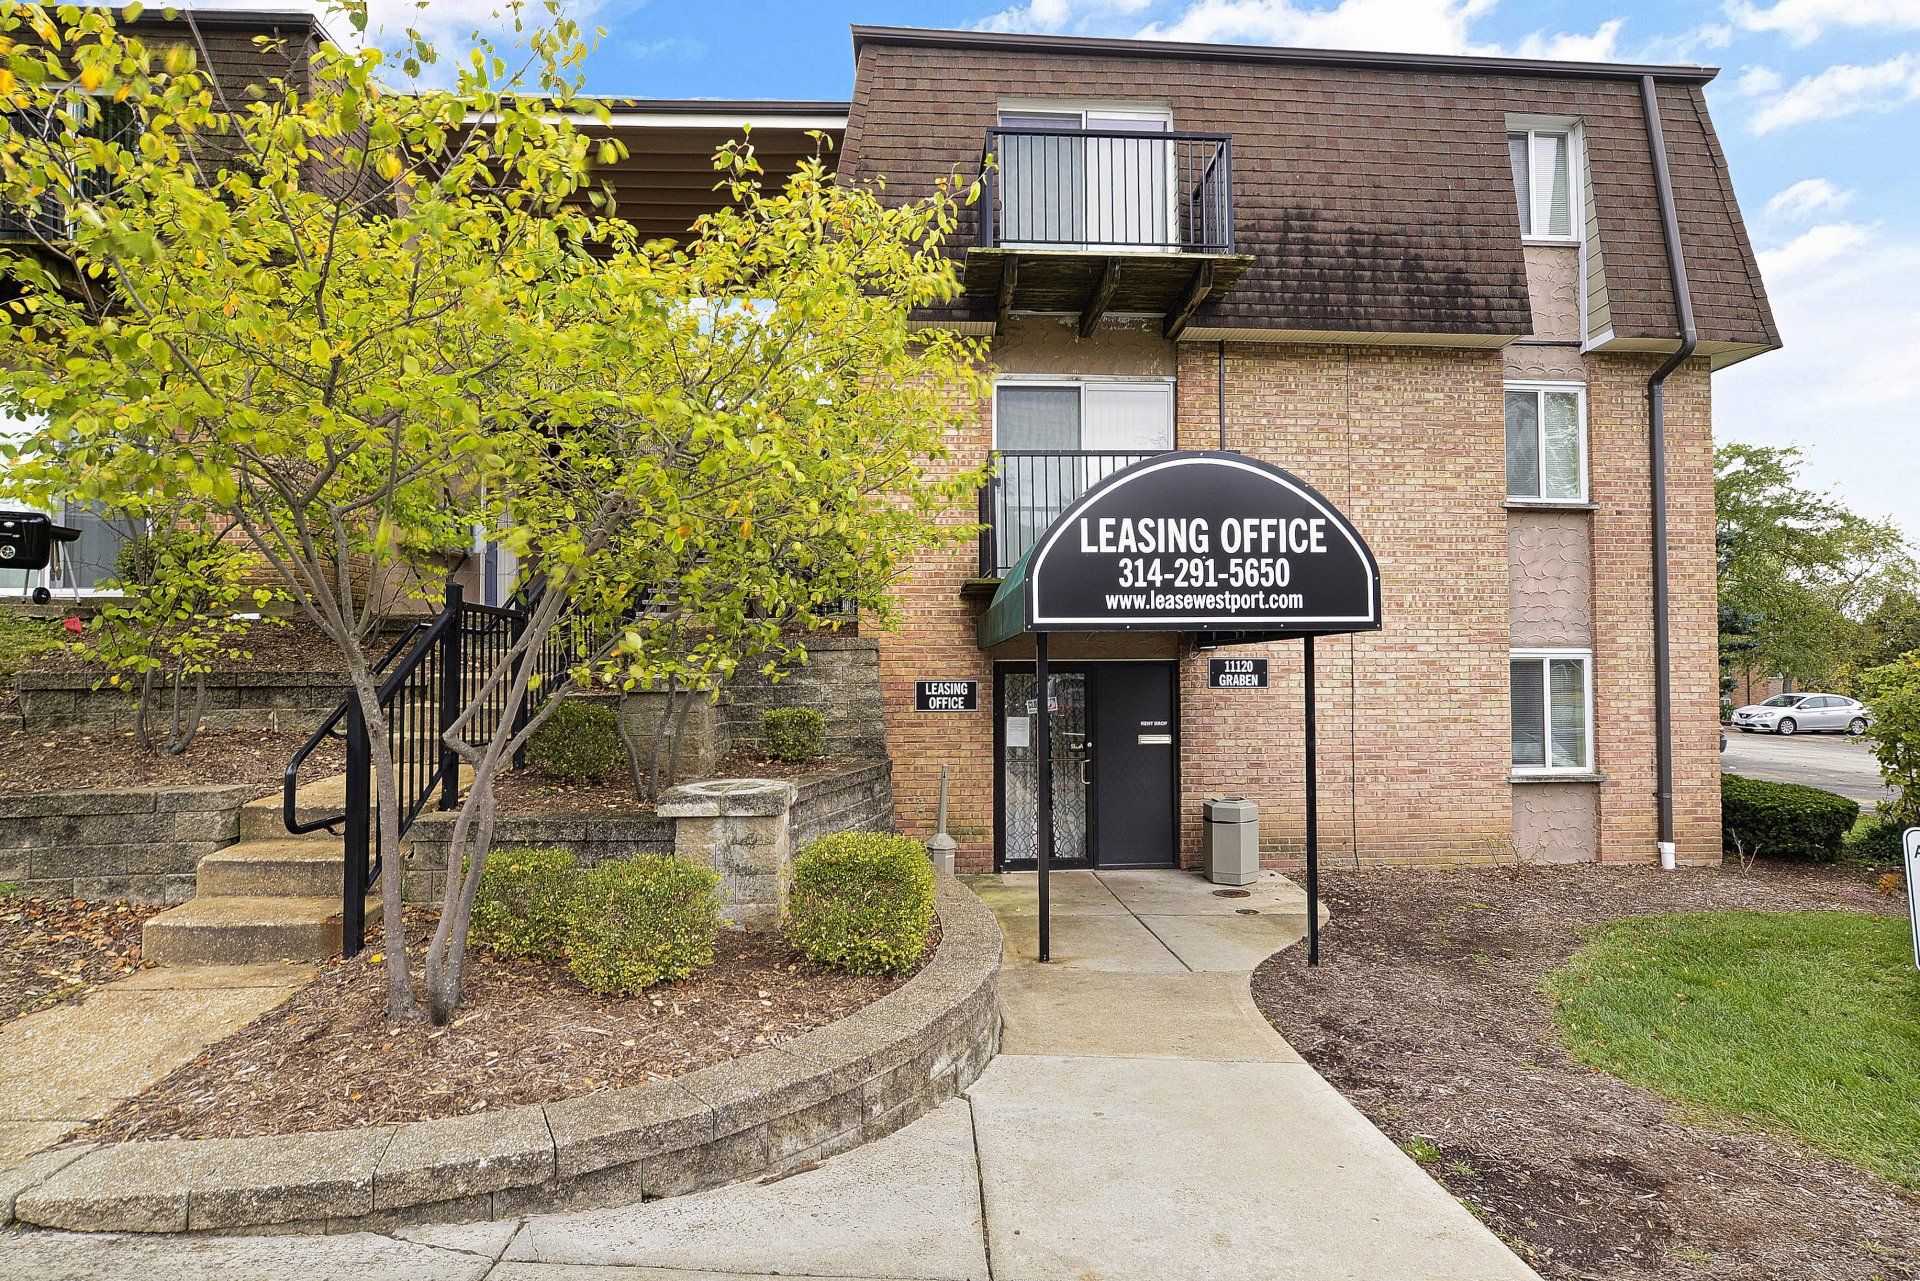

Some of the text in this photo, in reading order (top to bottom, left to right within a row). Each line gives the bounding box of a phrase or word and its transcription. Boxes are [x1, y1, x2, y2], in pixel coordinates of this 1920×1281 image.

[1080, 517, 1327, 553] LEASING OFFICE
[1118, 557, 1290, 588] 314-291-5650
[1105, 590, 1303, 613] www.leasewestport.com
[1224, 660, 1253, 673] 11120
[1219, 674, 1258, 686] GRABEN
[925, 682, 968, 695] LEASING
[928, 696, 964, 709] OFFICE
